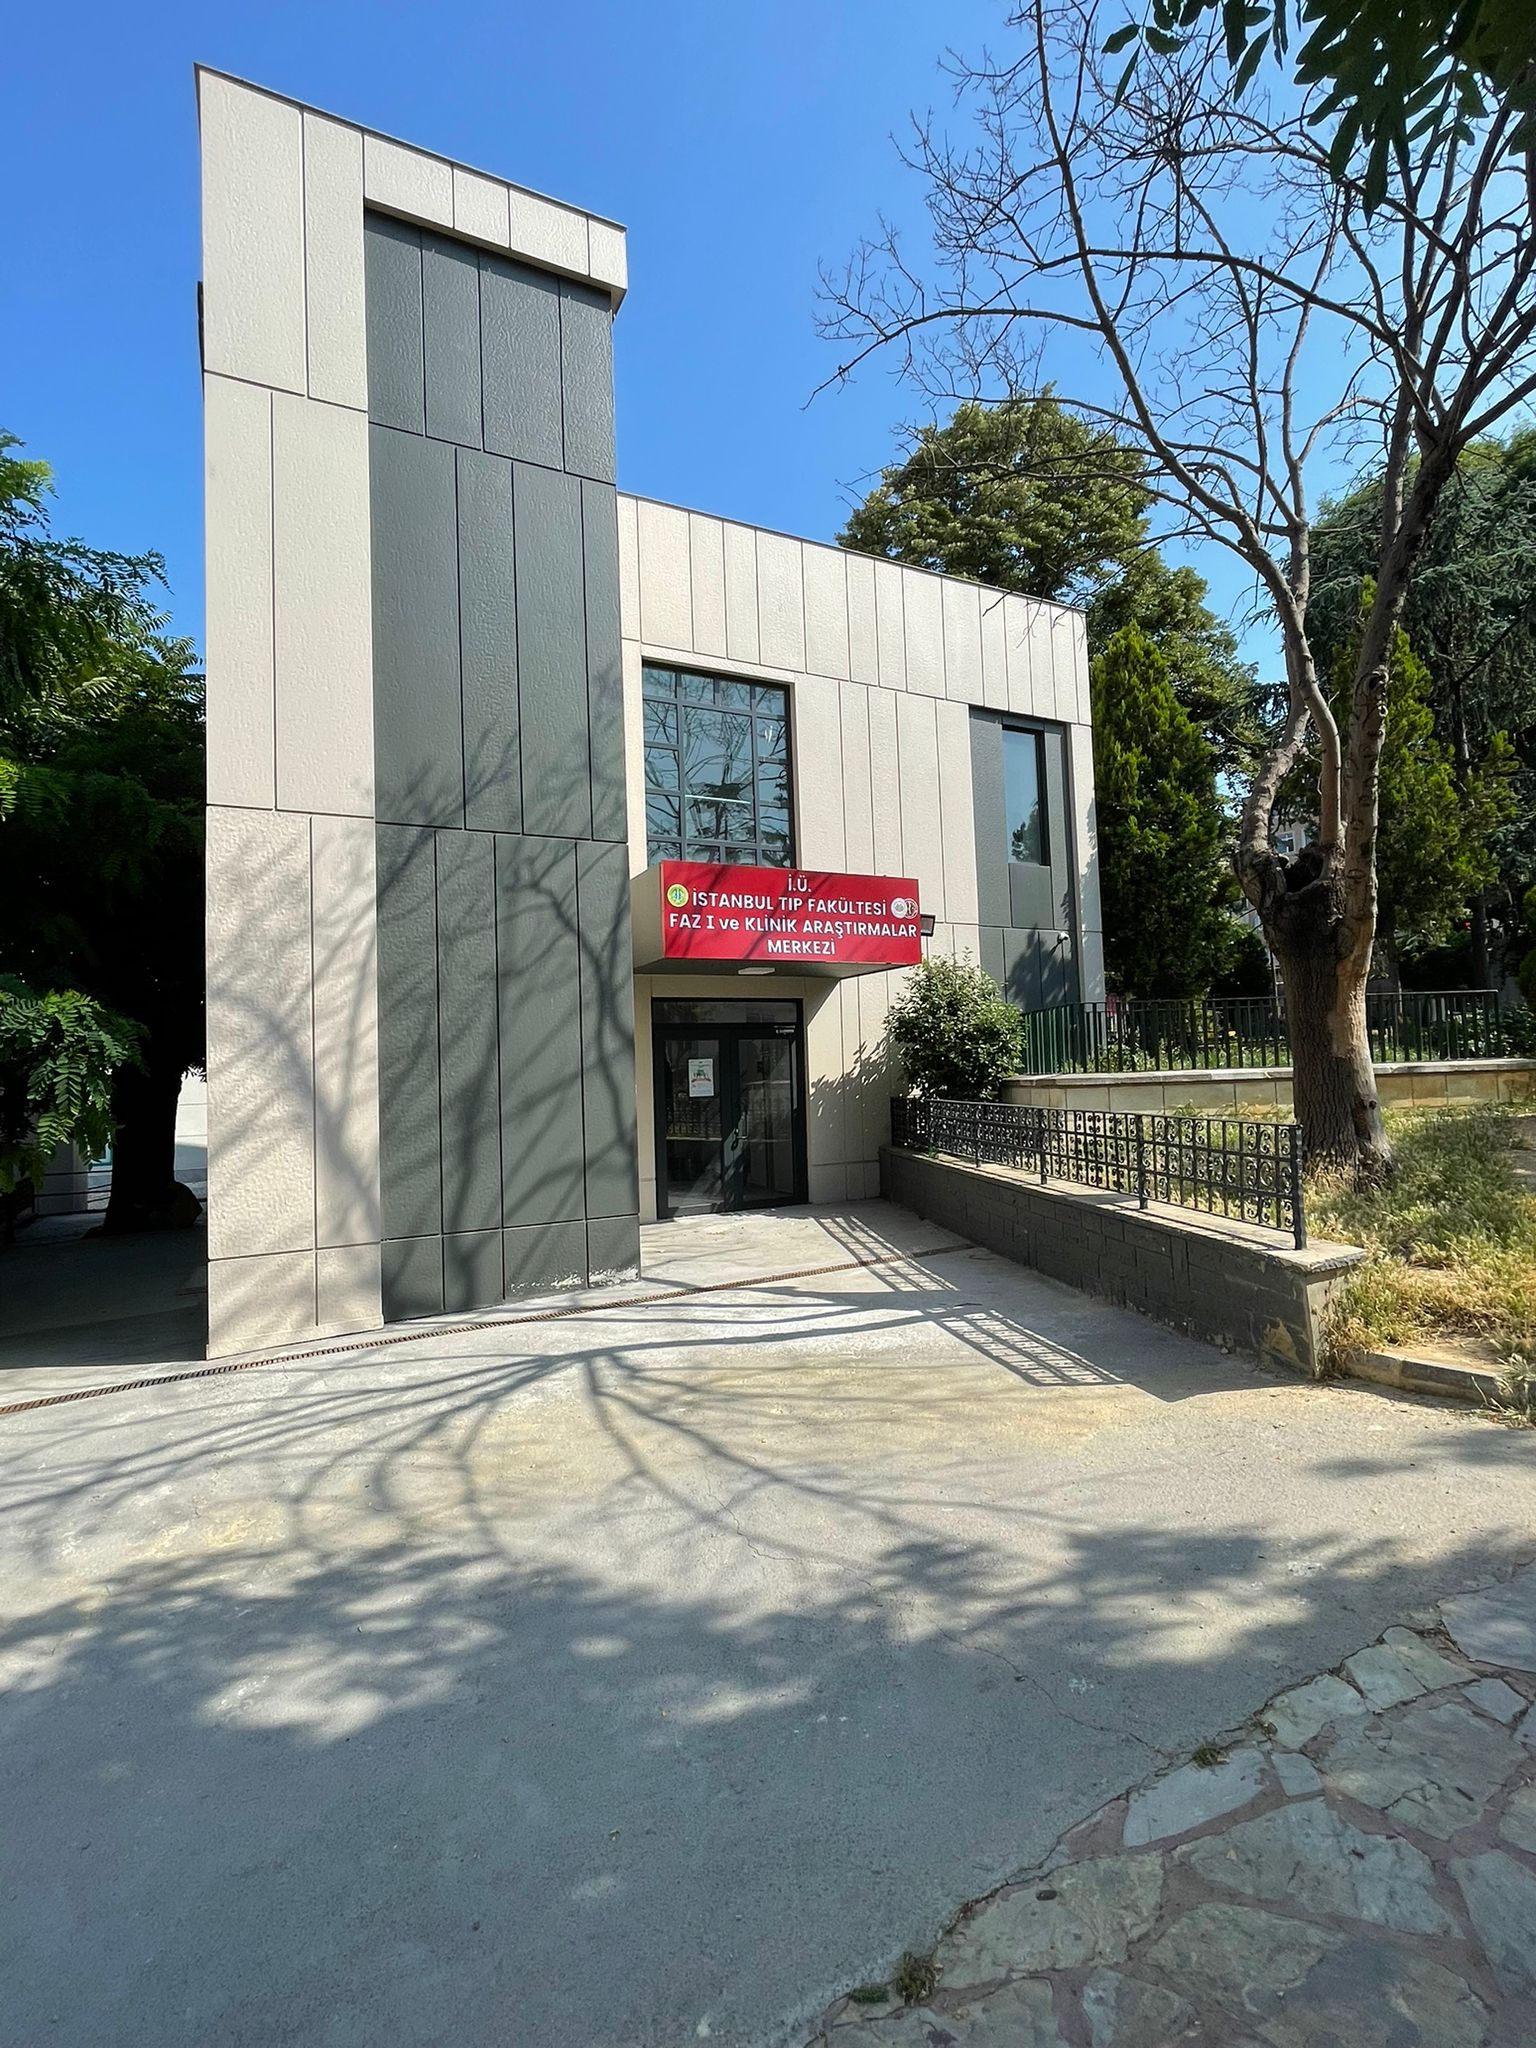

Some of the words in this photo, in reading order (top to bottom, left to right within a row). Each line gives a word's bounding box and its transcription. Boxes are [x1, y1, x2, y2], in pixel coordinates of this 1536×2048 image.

[788, 874, 811, 893] İ.Ü.
[692, 888, 774, 910] İSTANBUL
[779, 896, 803, 911] TIP
[807, 896, 886, 916] FAKÜLTESİ
[669, 913, 701, 929] FAZ
[706, 916, 715, 930] I
[719, 918, 739, 931] ve
[745, 914, 798, 933] KLİNİK
[802, 920, 917, 939] ARAŞTIRMALAR
[768, 938, 835, 955] MERKEZİ
